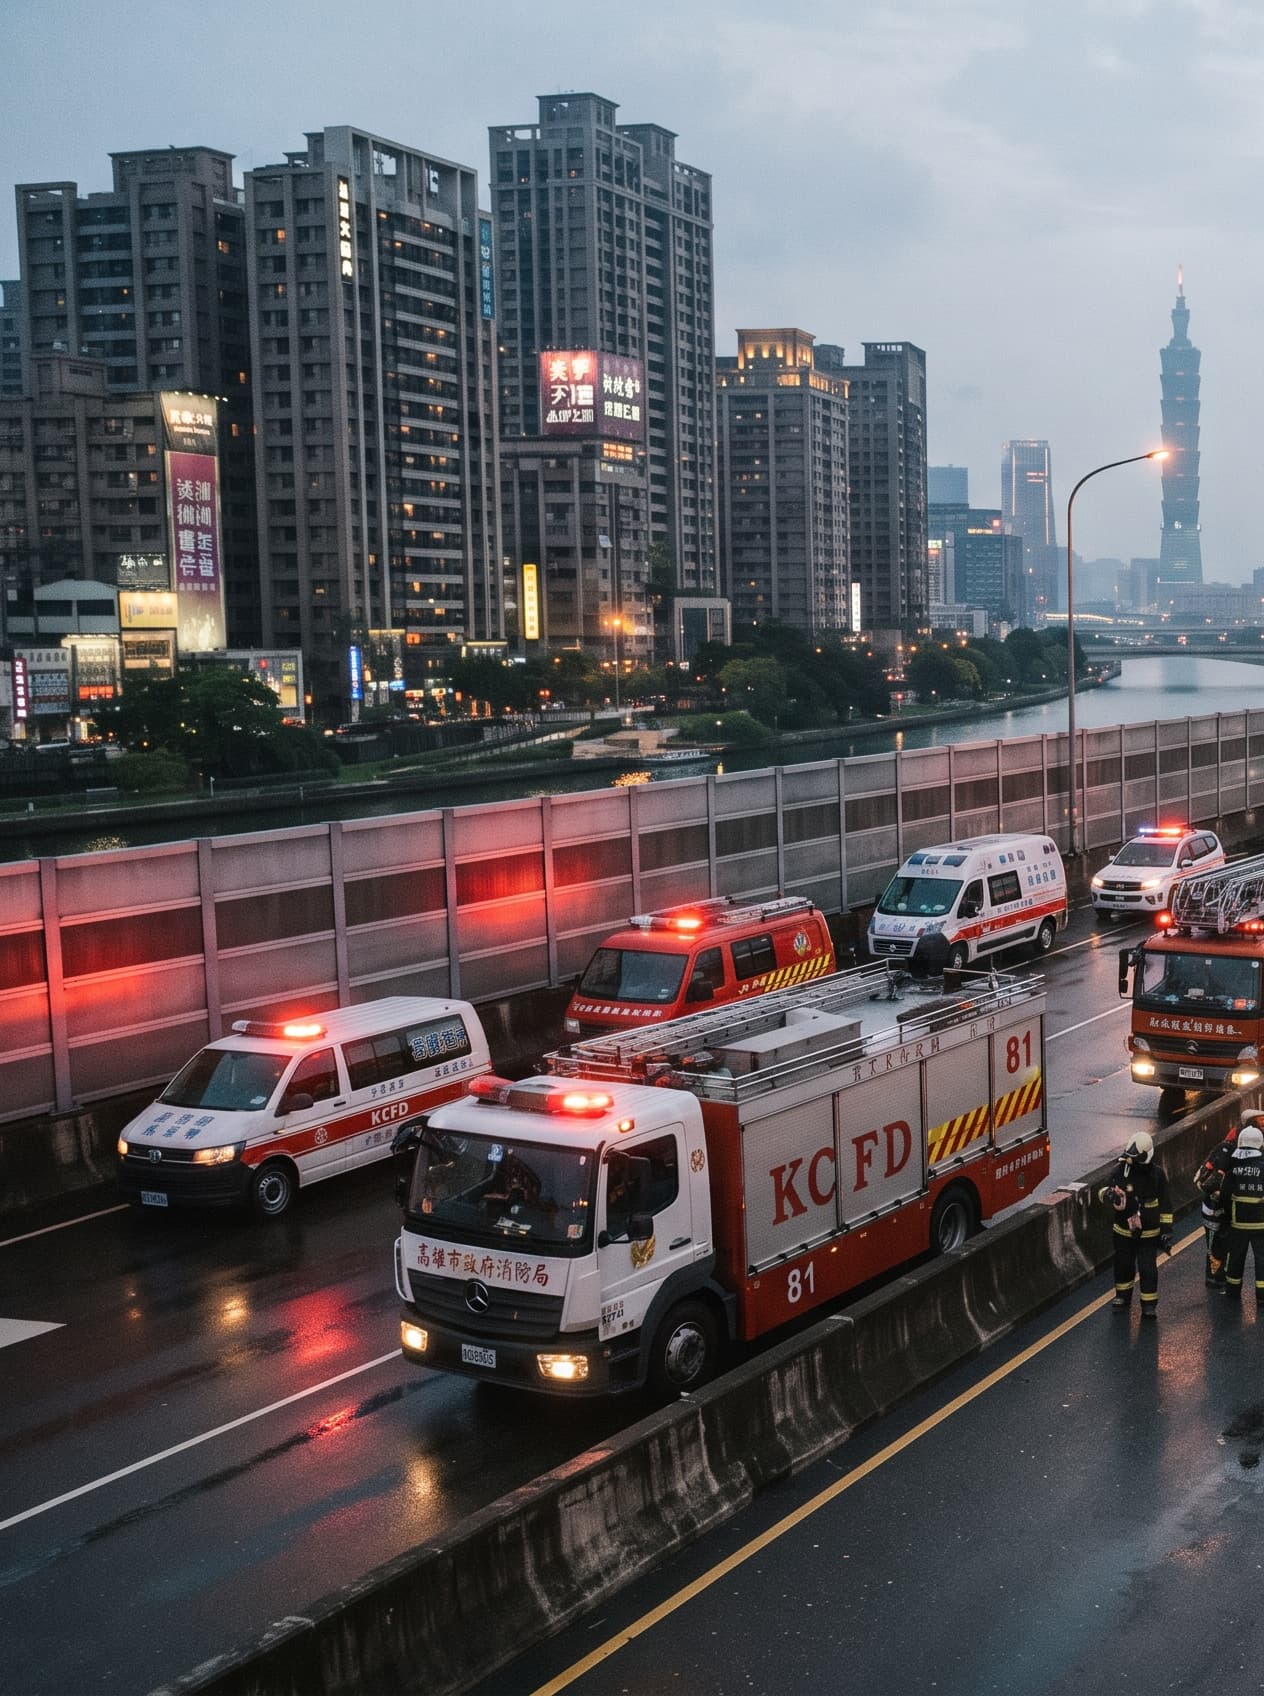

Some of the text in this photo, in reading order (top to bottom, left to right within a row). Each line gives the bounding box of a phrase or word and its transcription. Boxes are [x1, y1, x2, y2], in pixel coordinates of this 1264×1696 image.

[1006, 1030, 1031, 1074] 81
[371, 1101, 409, 1126] KCFD
[769, 1119, 912, 1226] KCFD
[787, 1260, 815, 1304] 81
